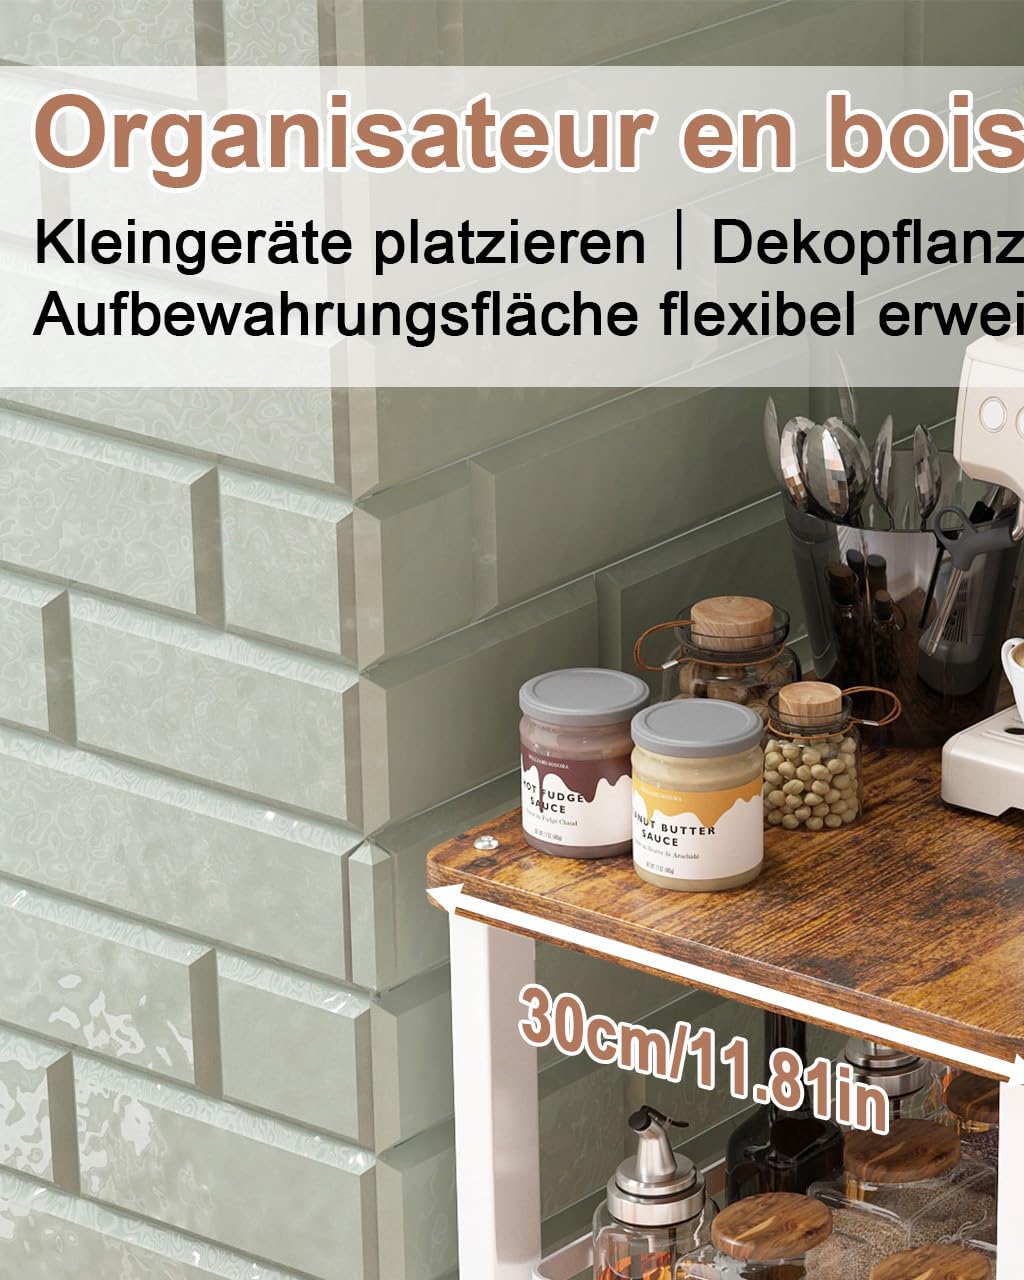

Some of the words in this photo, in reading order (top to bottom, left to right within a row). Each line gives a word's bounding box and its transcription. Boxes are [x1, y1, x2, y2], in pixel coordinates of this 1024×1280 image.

[542, 788, 584, 803] FUDGE
[530, 796, 567, 814] SAUCE
[642, 828, 679, 847] SAUCE
[661, 823, 716, 836] BUTTER
